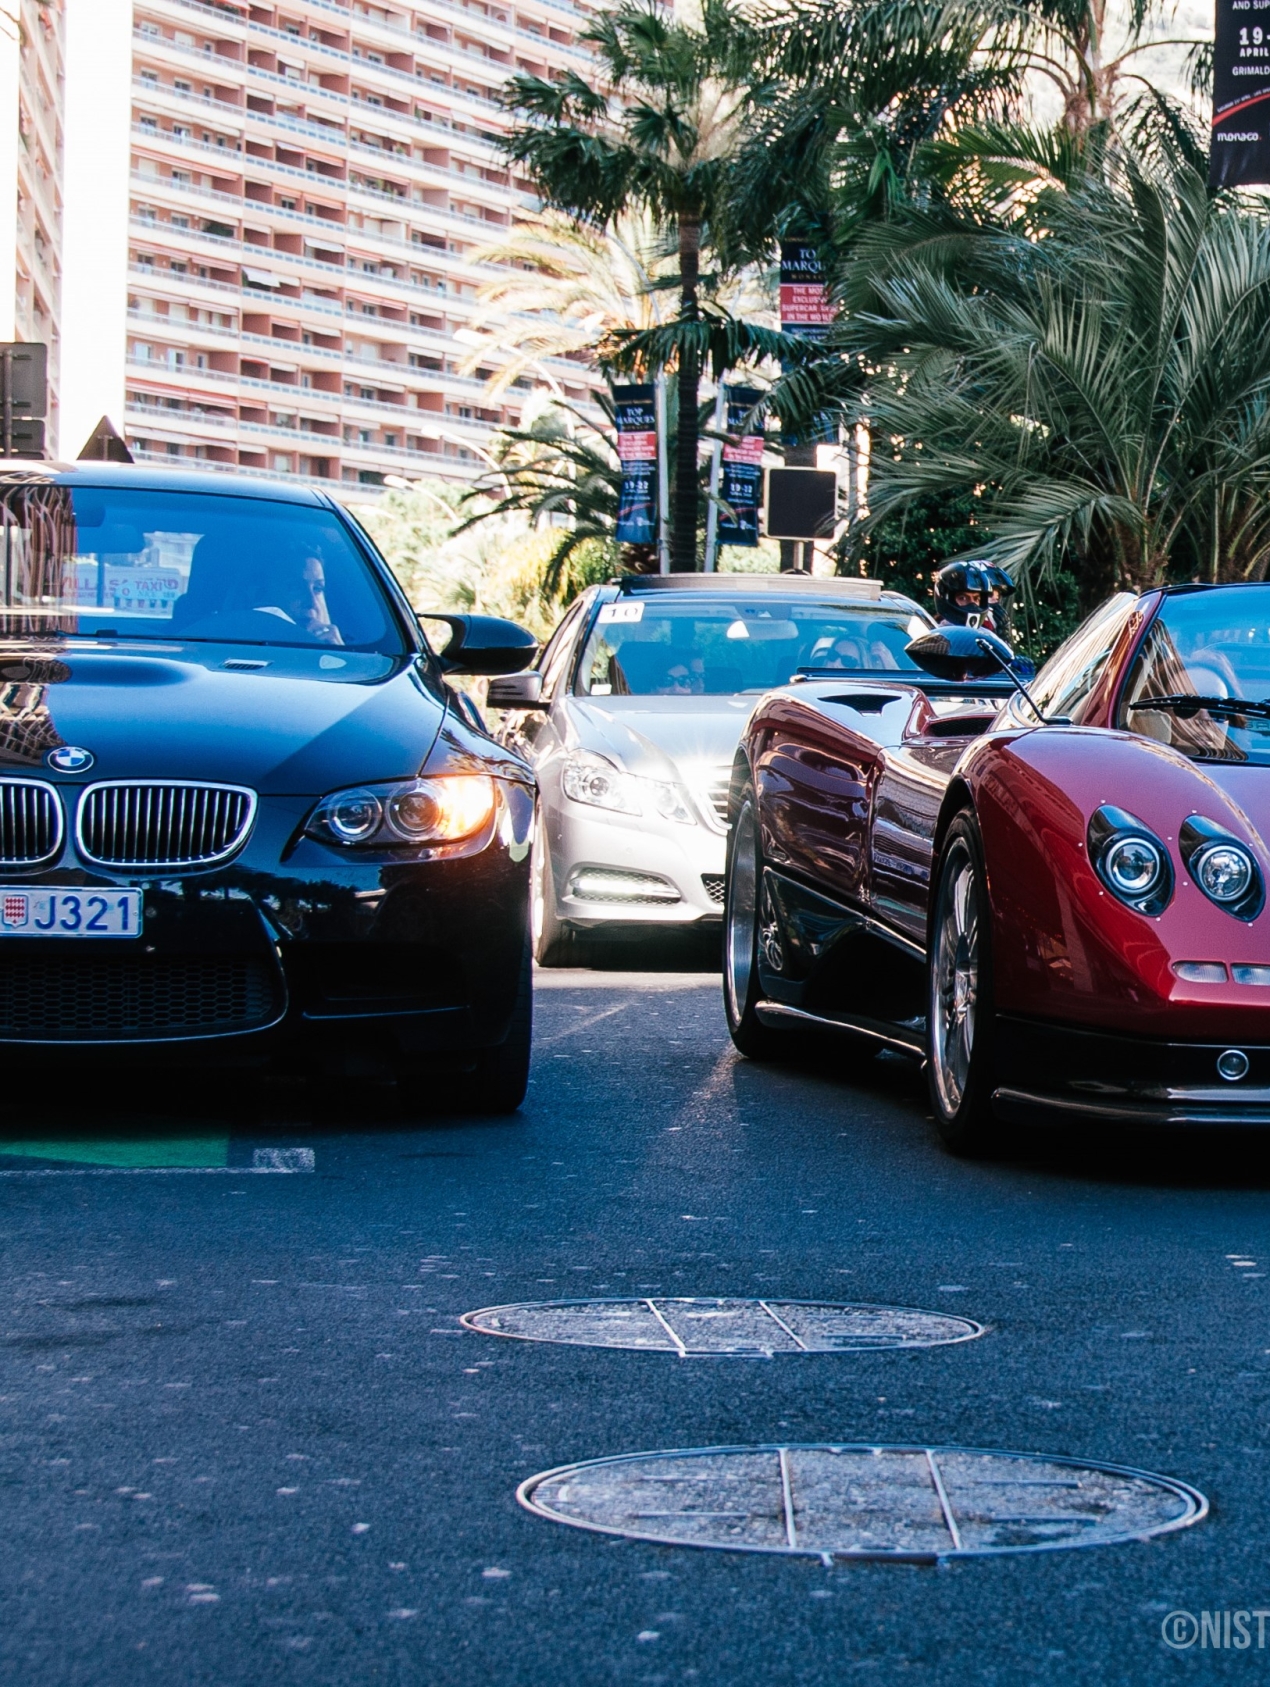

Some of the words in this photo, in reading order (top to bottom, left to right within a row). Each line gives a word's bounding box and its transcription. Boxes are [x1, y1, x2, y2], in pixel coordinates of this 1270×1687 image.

[1232, 0, 1251, 10] AND
[1239, 47, 1270, 57] APRIL
[800, 249, 816, 259] TO
[34, 895, 129, 931] J321
